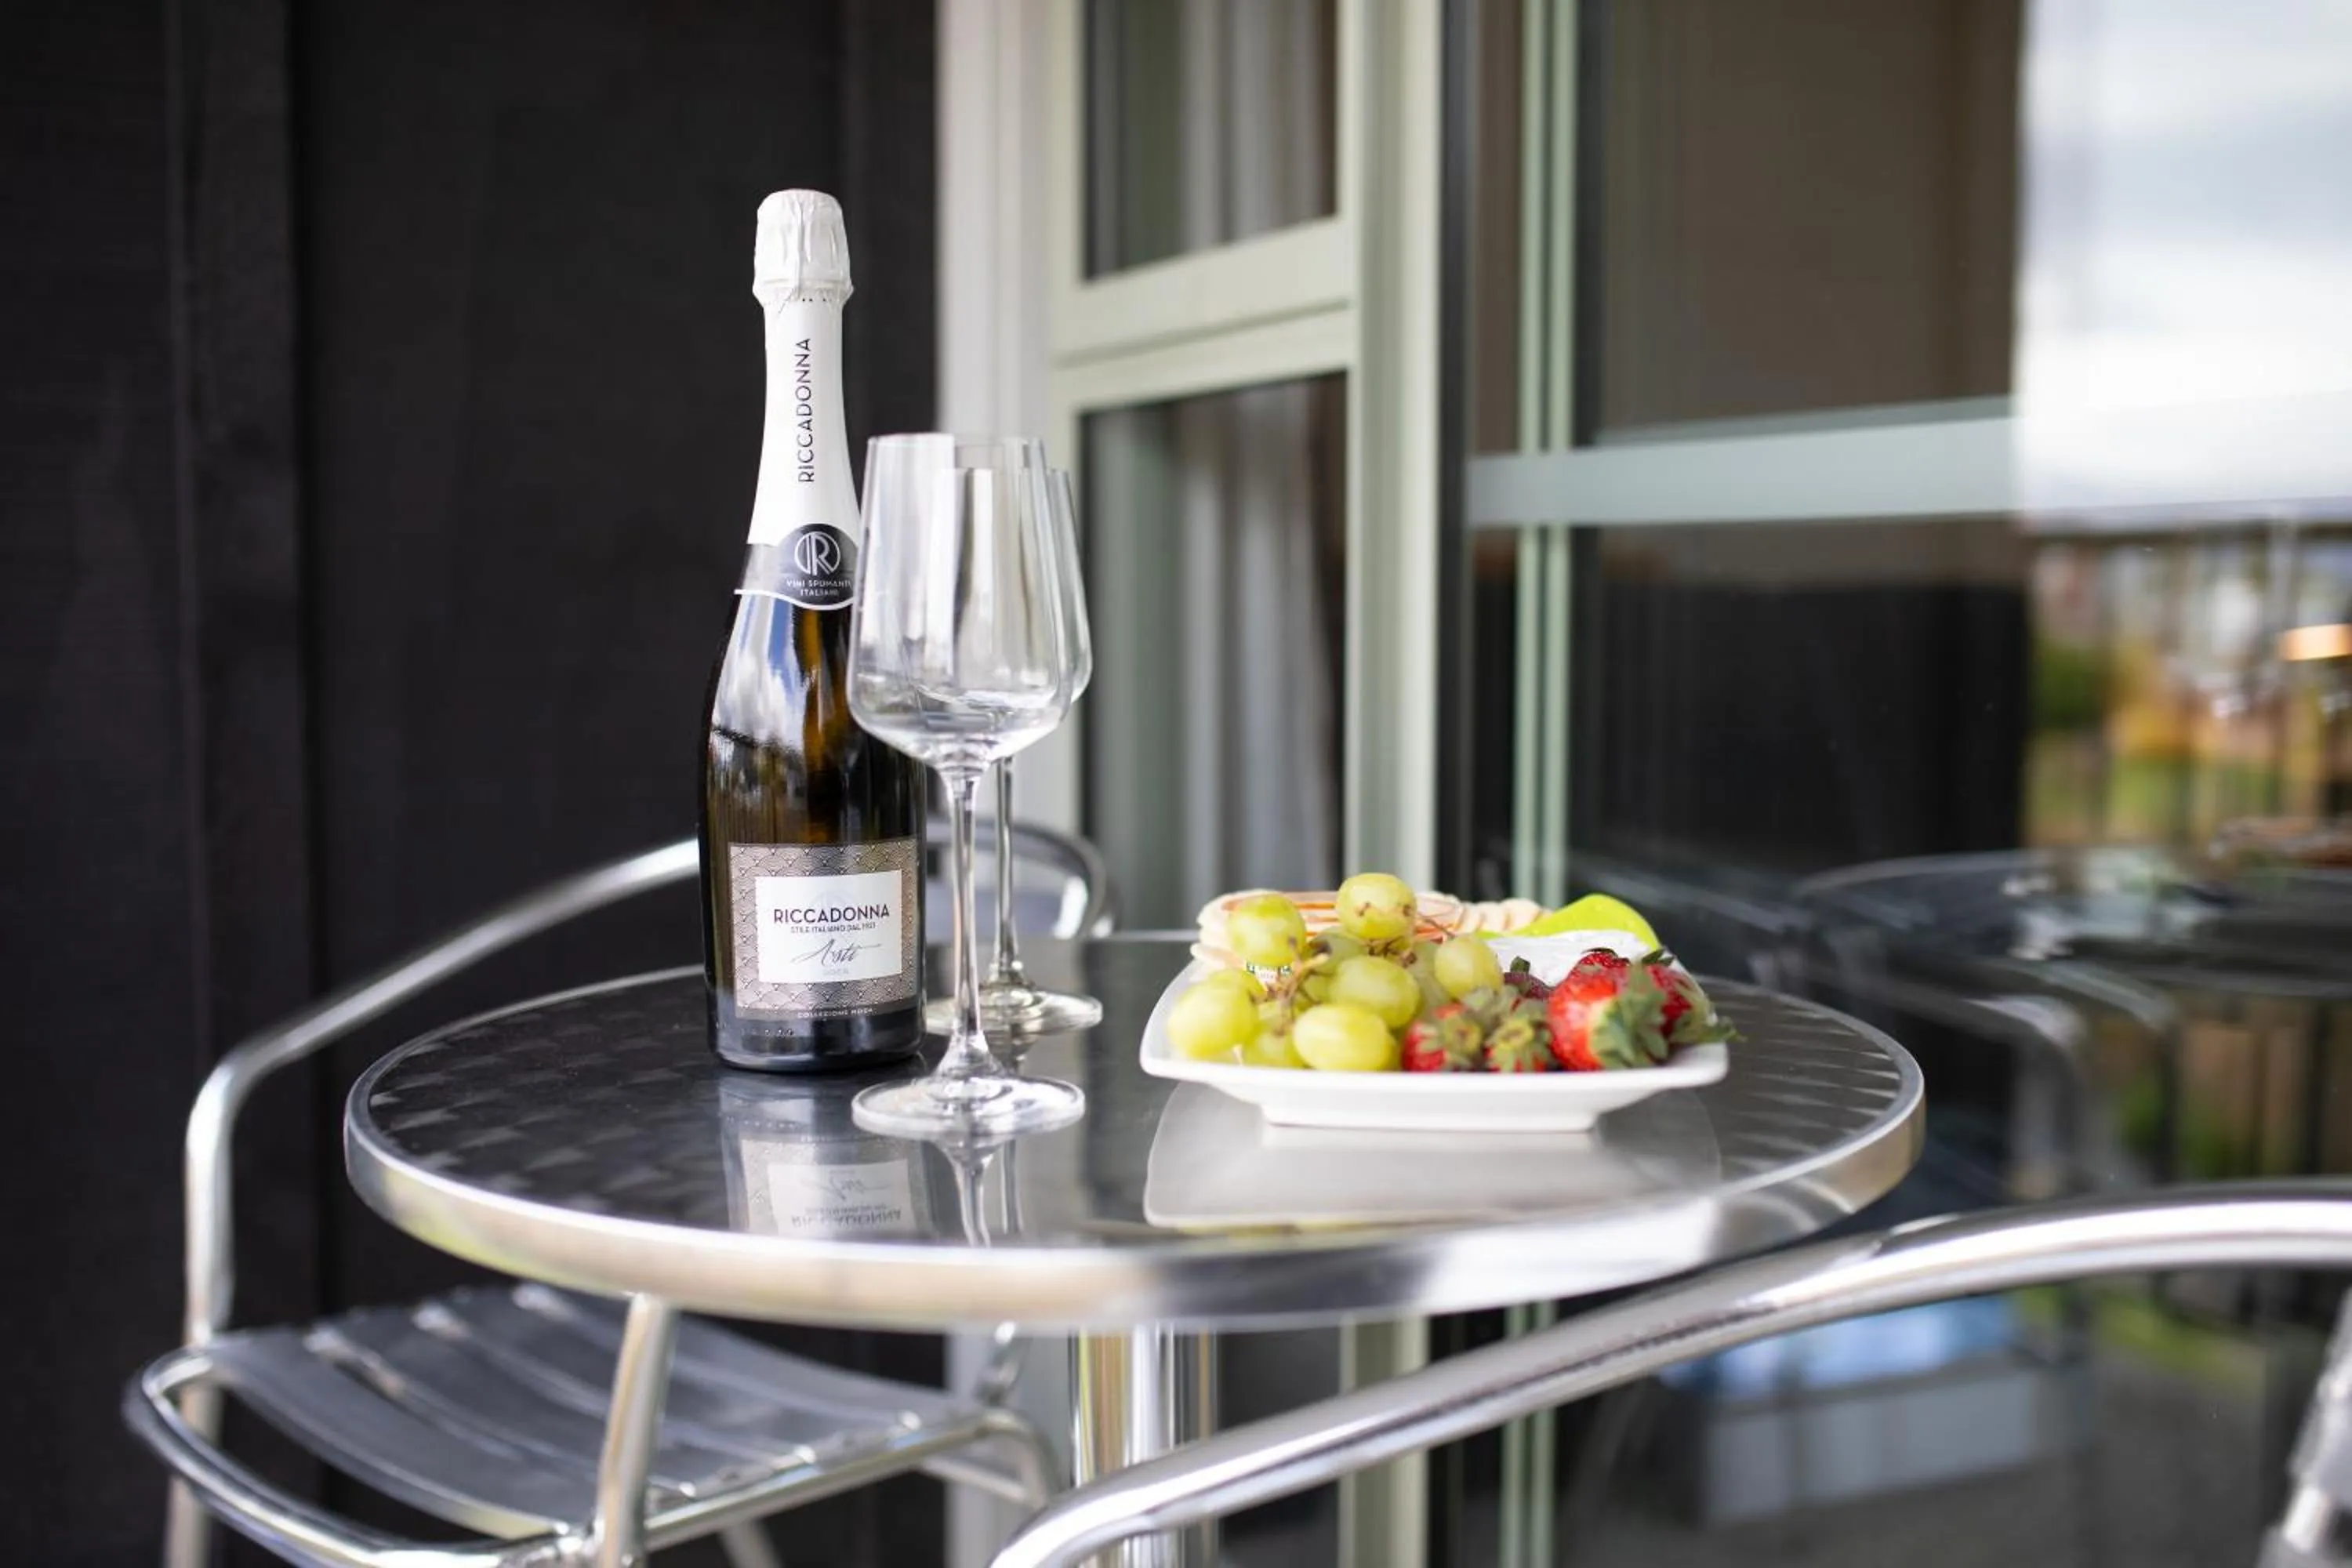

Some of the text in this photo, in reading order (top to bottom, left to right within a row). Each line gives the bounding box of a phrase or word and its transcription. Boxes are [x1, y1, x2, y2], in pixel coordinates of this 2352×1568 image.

[795, 338, 815, 483] RICCADONNA
[786, 579, 805, 588] VINI
[774, 903, 890, 924] RICCADONNA
